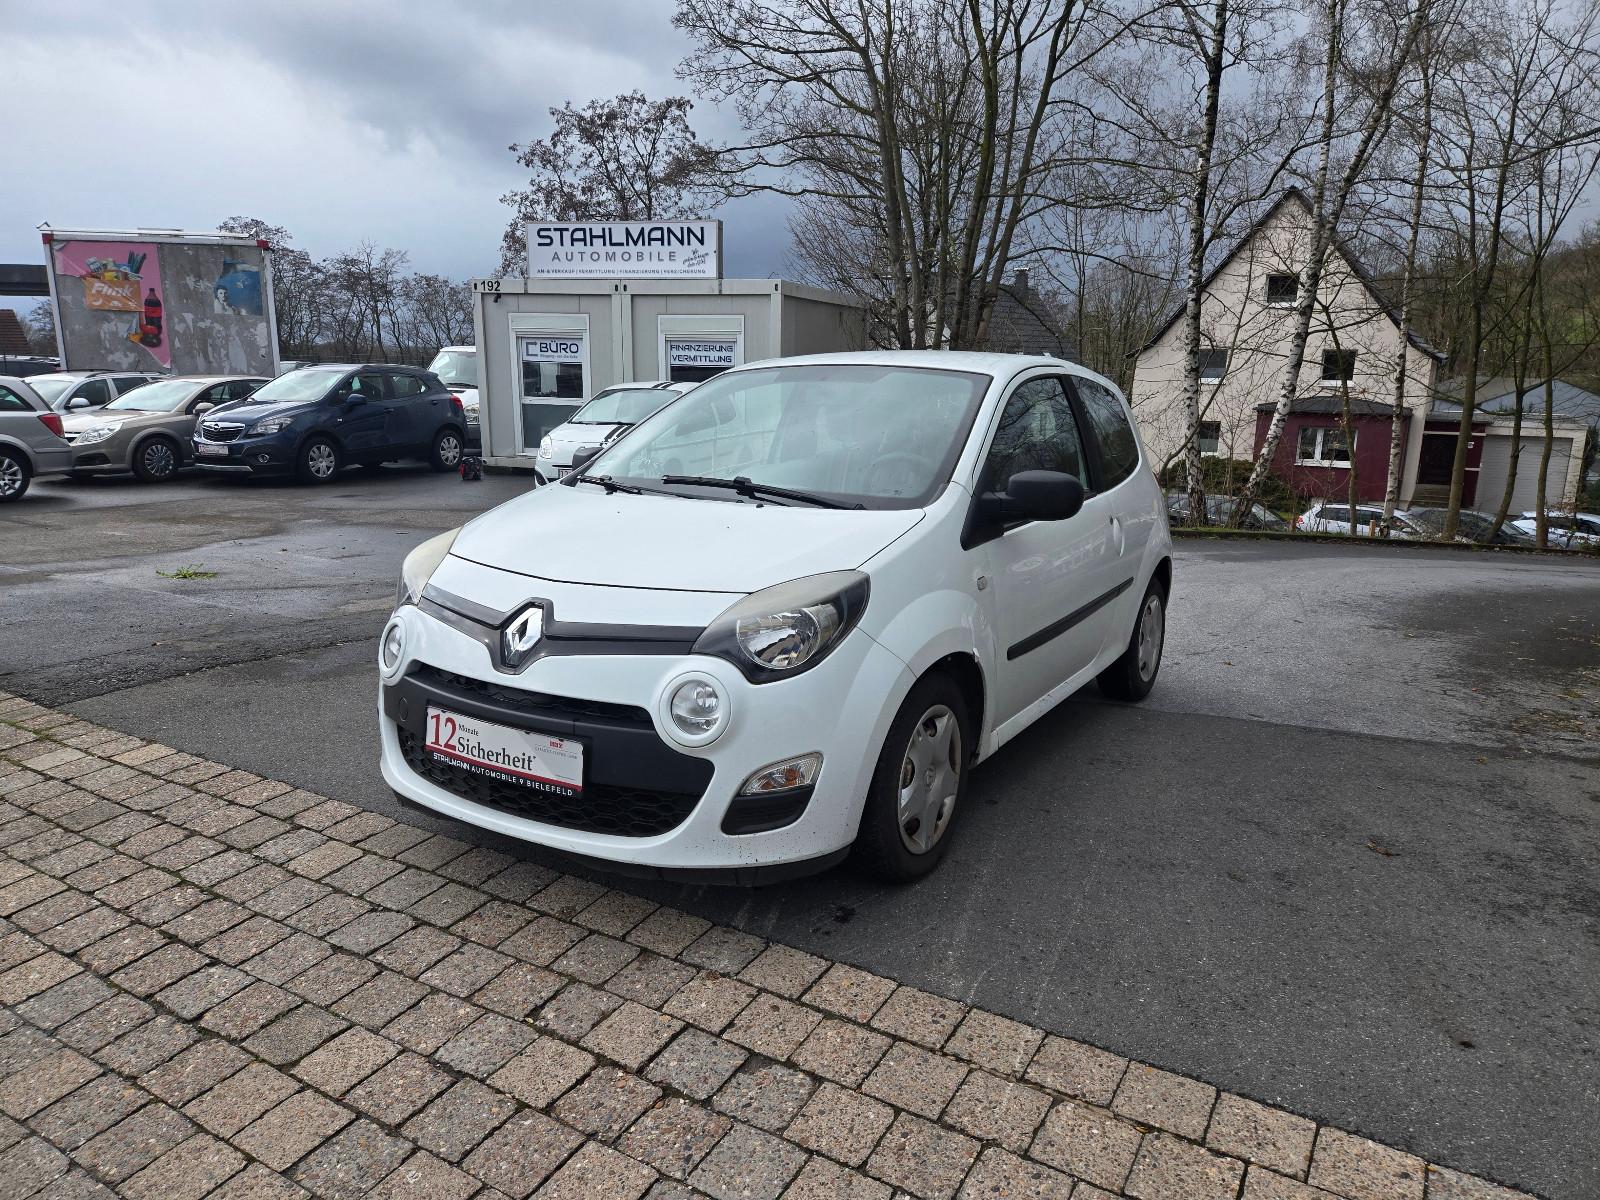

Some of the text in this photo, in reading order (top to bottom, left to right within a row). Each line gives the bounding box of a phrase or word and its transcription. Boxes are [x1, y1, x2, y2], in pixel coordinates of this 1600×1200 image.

[536, 227, 705, 247] STAHLMANN
[551, 251, 677, 262] AUTOMOBILE
[480, 280, 501, 291] 192
[539, 340, 579, 354] BÜRO
[670, 344, 733, 352] FINANZIERUNG
[671, 354, 732, 363] VERMITTLUNG
[430, 713, 457, 752] 12
[433, 752, 574, 796] STAHLMANN AUTOMOBILE BIELEFELD
